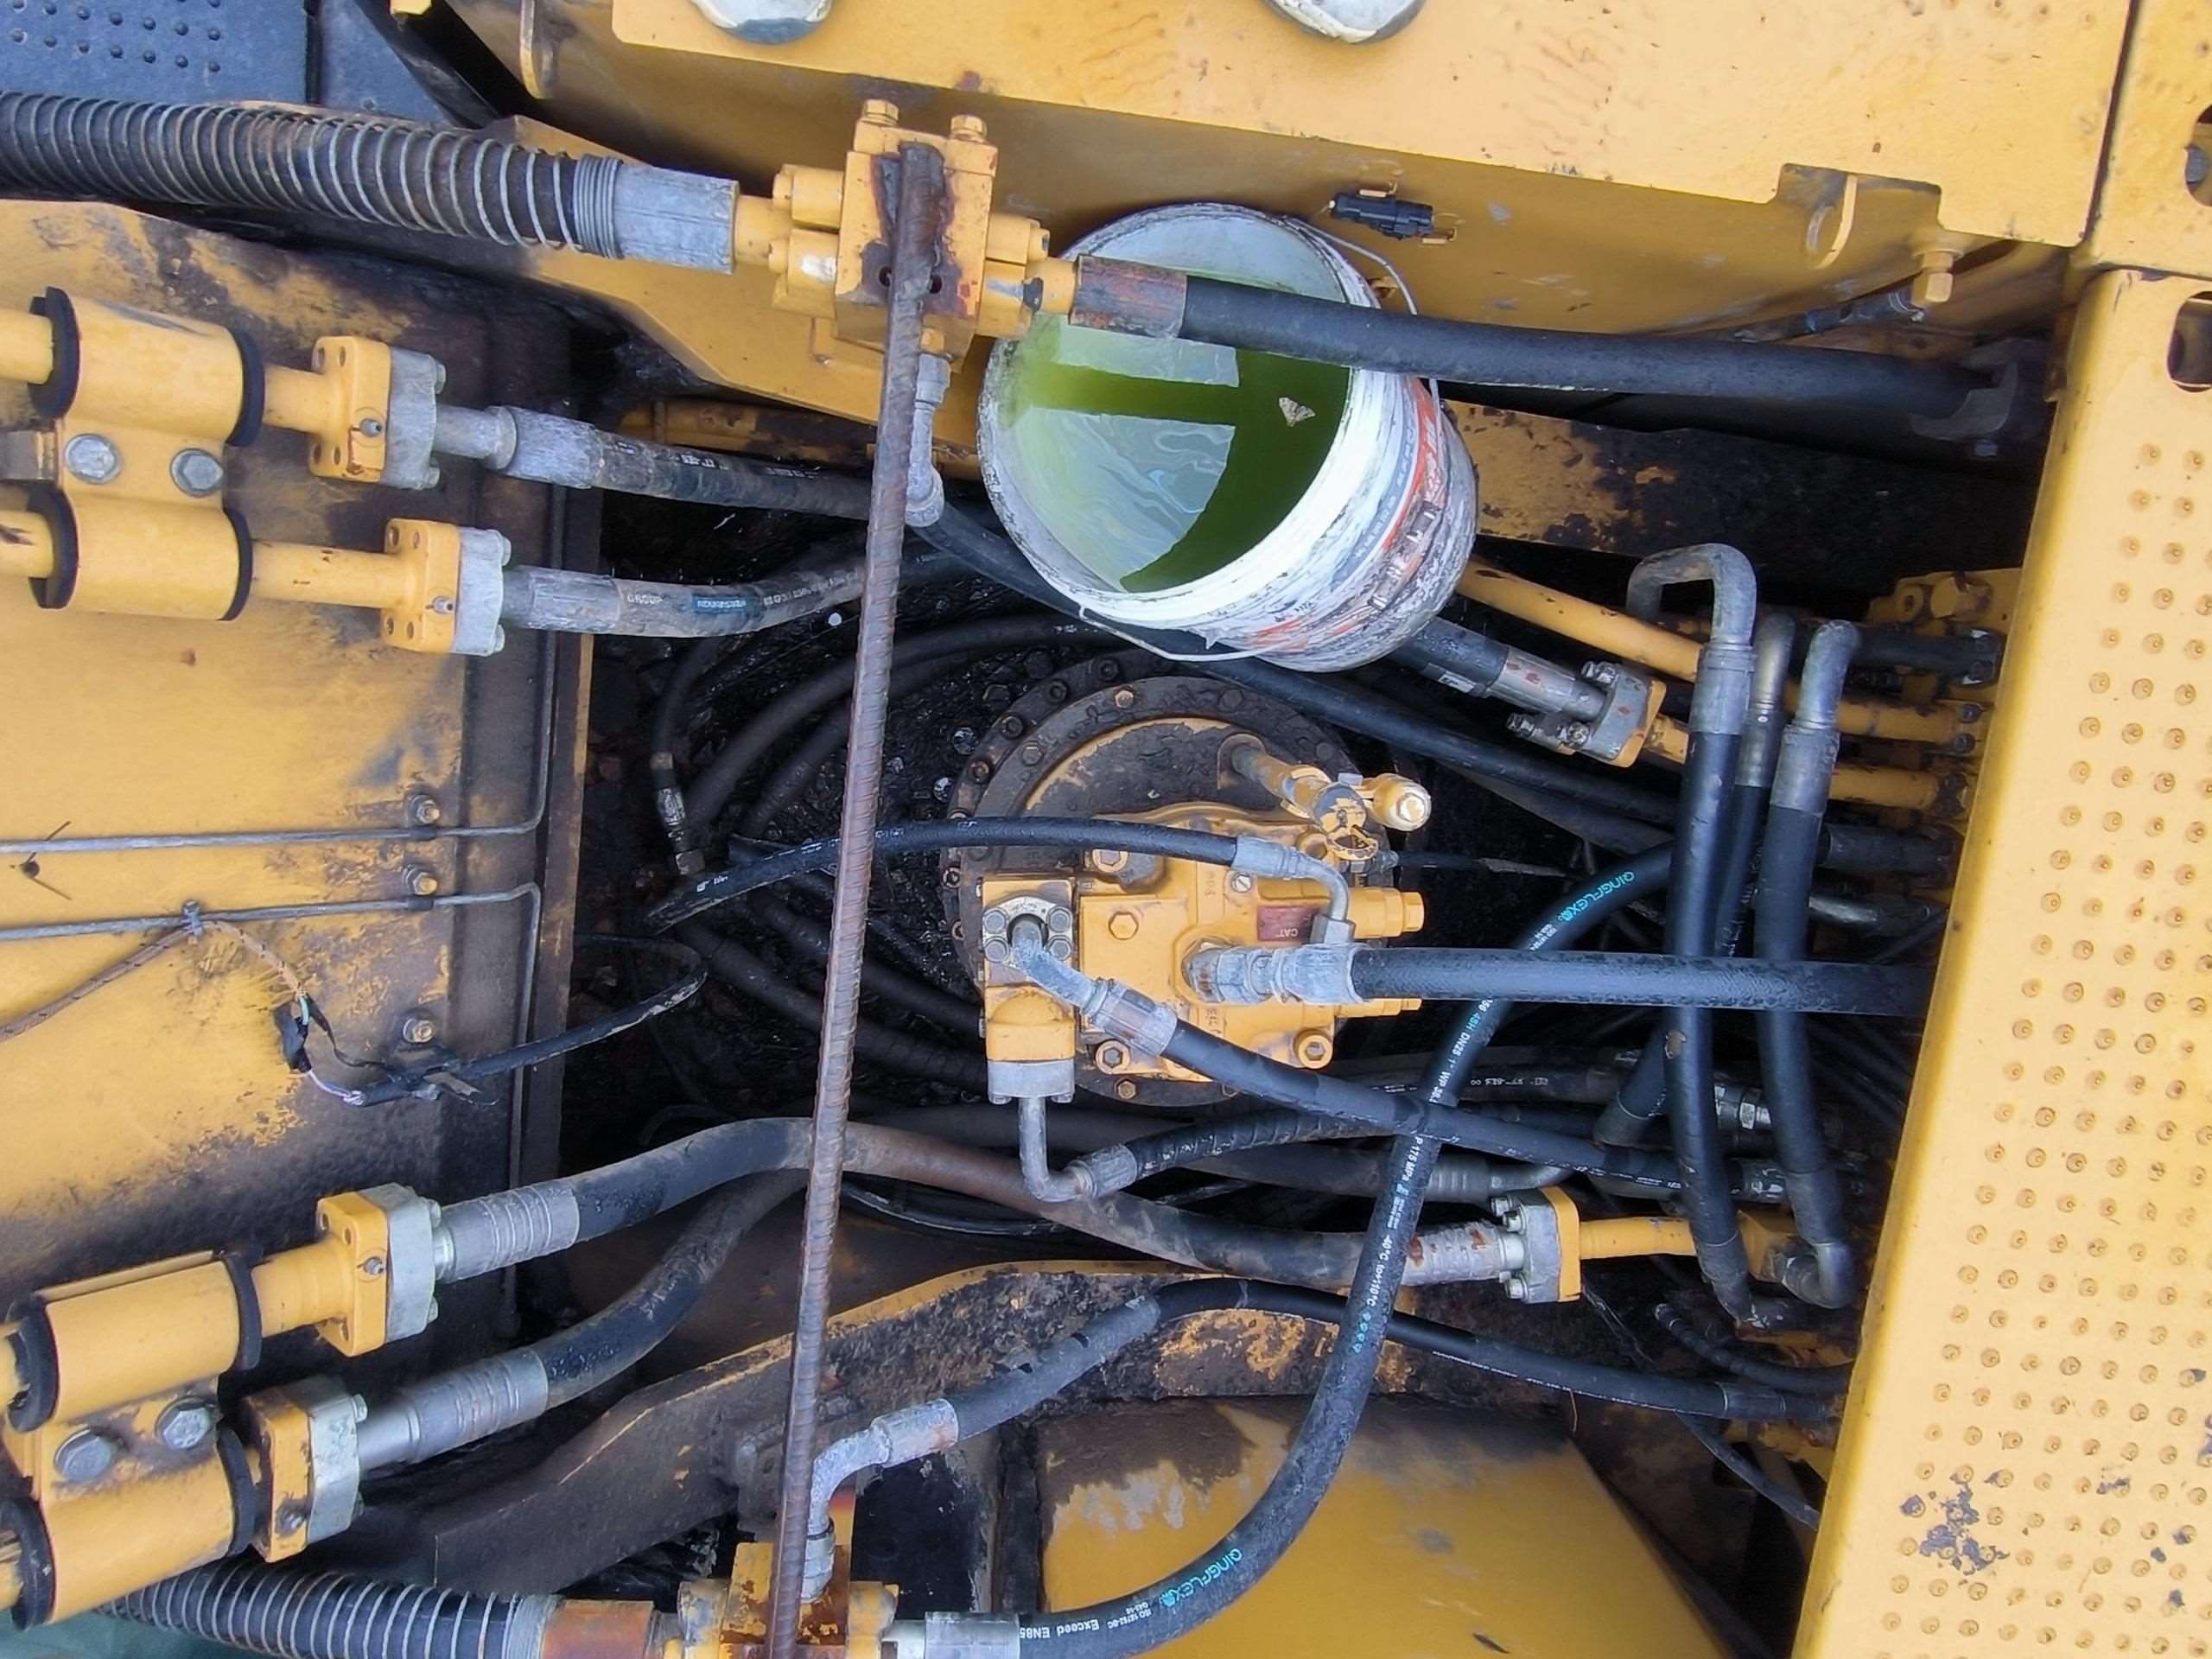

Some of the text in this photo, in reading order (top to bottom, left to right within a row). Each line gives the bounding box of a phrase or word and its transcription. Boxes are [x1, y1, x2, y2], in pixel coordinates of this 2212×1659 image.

[1280, 928, 1299, 938] CAT
[1465, 1012, 1480, 1031] 4SH
[1452, 1032, 1470, 1056] DN25
[1438, 1071, 1452, 1086] WP
[1408, 1146, 1421, 1161] 175
